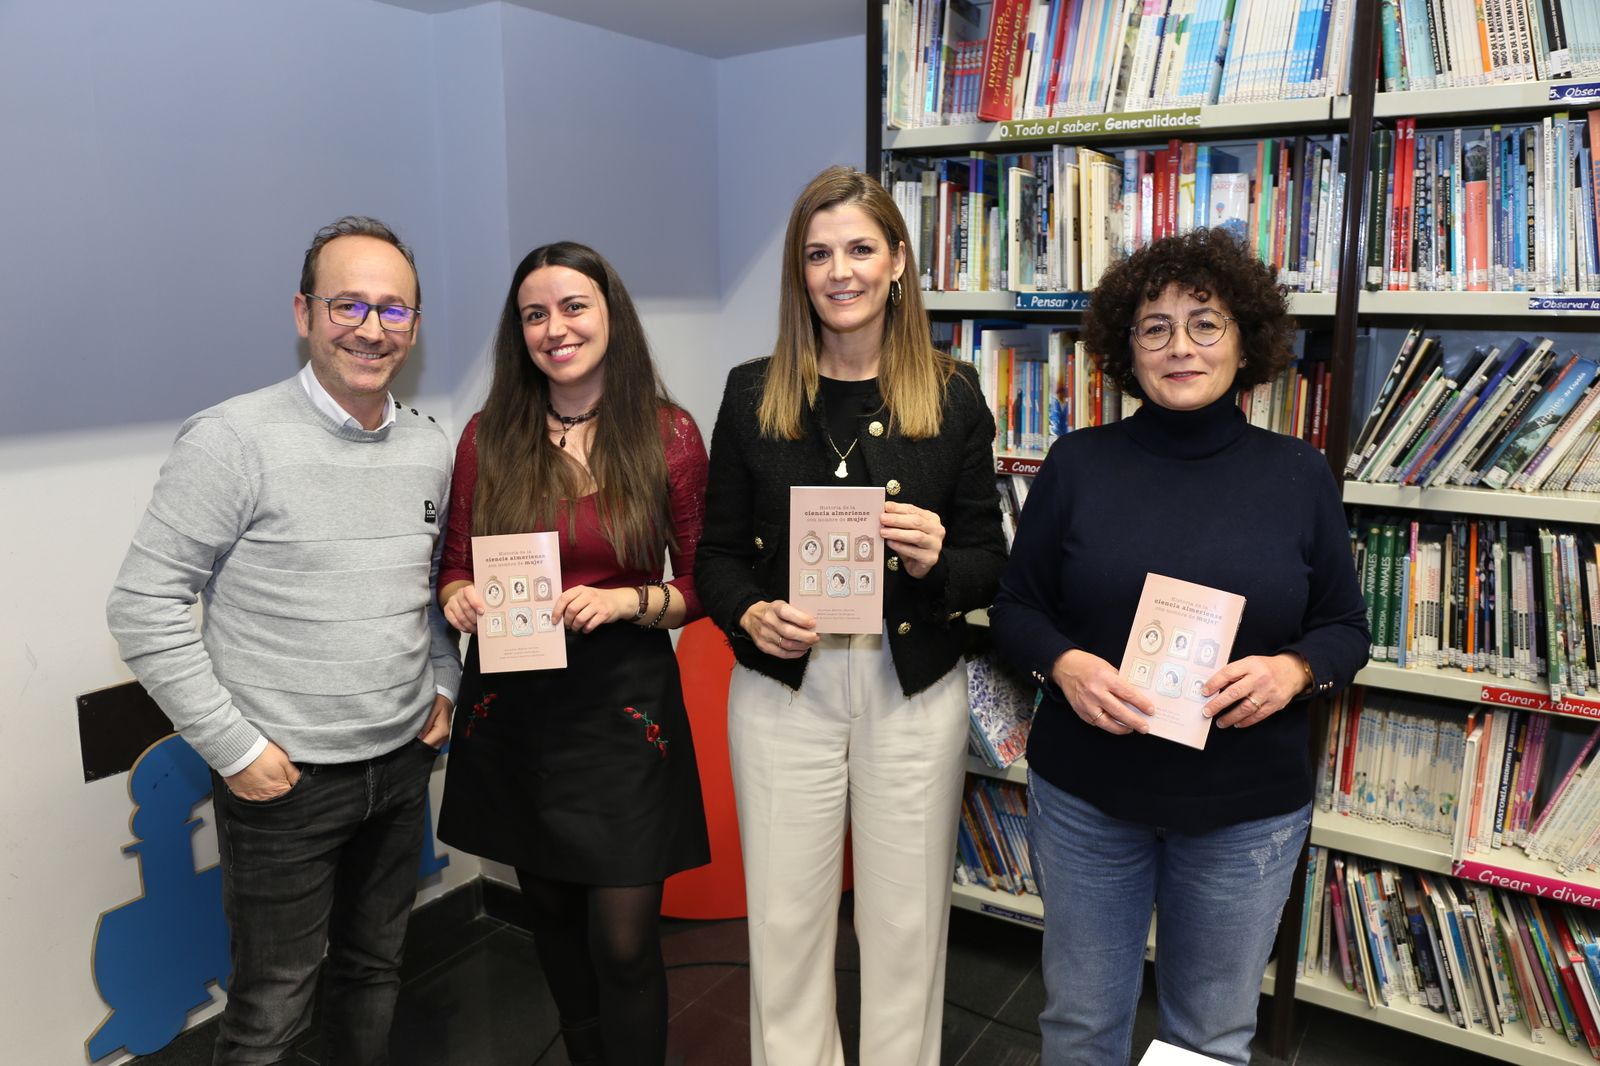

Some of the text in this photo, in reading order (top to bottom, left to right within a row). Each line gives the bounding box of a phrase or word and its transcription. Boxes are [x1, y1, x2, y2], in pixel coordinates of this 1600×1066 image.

[987, 11, 1006, 87] INVENTOS,
[1003, 3, 1024, 106] CURIOSIDADES
[1001, 113, 1200, 137] 0. Todo el saber. Generalidades
[1406, 127, 1415, 139] 2
[1016, 296, 1027, 307] 1.
[1031, 296, 1068, 307] Pensar
[1071, 299, 1078, 310] y
[1542, 300, 1589, 309] Observar
[1590, 300, 1600, 309] la
[997, 460, 1008, 471] 2.
[525, 559, 544, 568] mujer
[1366, 553, 1377, 593] ANIMALES
[1380, 556, 1390, 597] ANIMALES
[1393, 557, 1403, 597] ANIMALES
[1154, 598, 1180, 610] ciencia
[1481, 690, 1494, 700] 6.
[1499, 692, 1535, 705] Curar
[1538, 700, 1547, 709] y
[1494, 784, 1509, 831] ANATOMÍA
[1478, 870, 1530, 890] Crear
[1536, 885, 1547, 896] y
[1552, 886, 1600, 907] diver
